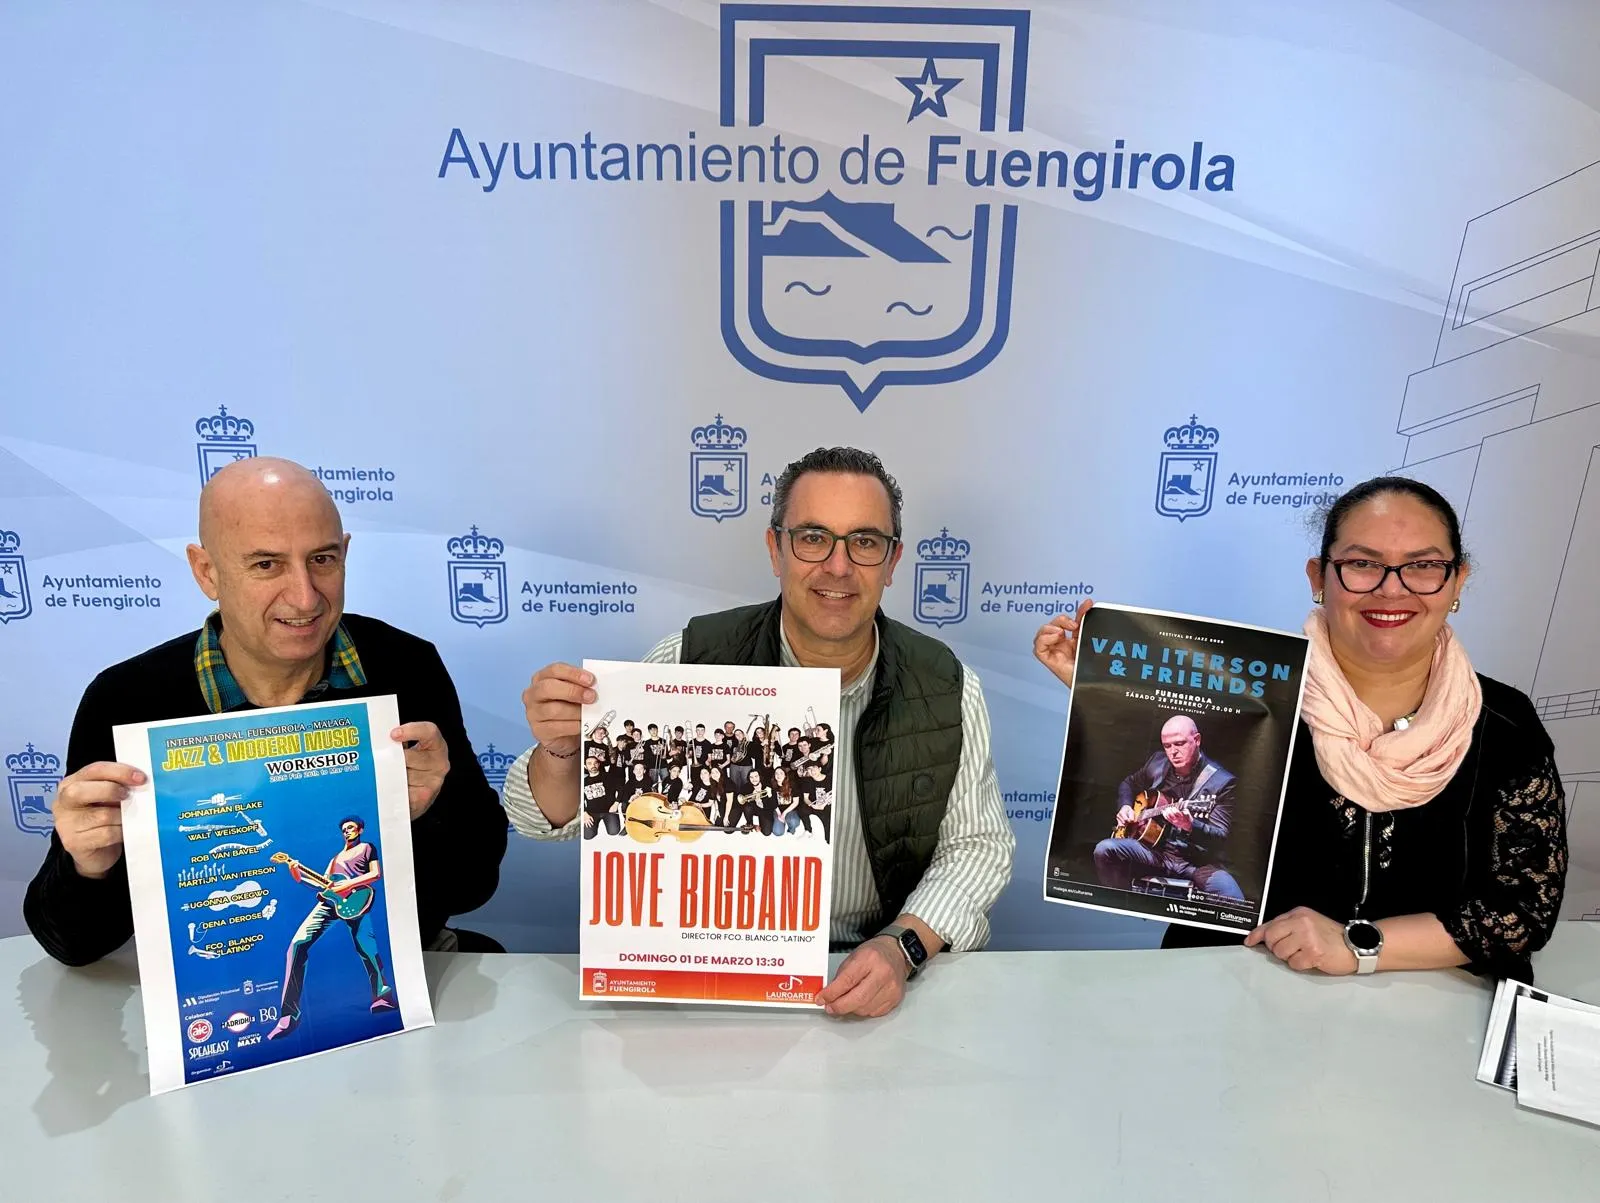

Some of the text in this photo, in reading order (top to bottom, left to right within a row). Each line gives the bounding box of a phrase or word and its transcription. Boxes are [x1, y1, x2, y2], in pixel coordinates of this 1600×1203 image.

[437, 127, 1236, 202] Ayuntamiento de Fuengirola
[312, 466, 395, 481] tamiento
[1228, 472, 1344, 489] Ayuntamiento
[1226, 491, 1339, 508] de Fuengirola
[42, 574, 161, 591] Ayuntamiento
[521, 581, 638, 597] Ayuntamiento
[981, 581, 1094, 597] Ayuntamiento
[45, 594, 161, 610] de Fuengirola
[522, 600, 635, 616] de Fuengirola
[980, 600, 1079, 616] de Fuengirol
[1091, 637, 1290, 681] VAN ITERSON
[1109, 659, 1266, 698] & FRIENDS
[645, 683, 777, 697] PLAZA REYES CATÓLICOS
[1155, 689, 1213, 704] FUENGIROLA
[1125, 690, 1156, 702] SÁBADO
[1169, 698, 1203, 709] FEBRERO
[166, 729, 244, 747] INTERNATIONAL
[246, 723, 306, 739] FUENGIROLA
[162, 727, 359, 771] JAZZ & MODERN MUSIC
[265, 751, 359, 775] WORKSHOP
[178, 801, 263, 820] JOHNATHAN BLAKE
[187, 831, 212, 841] WALT
[191, 846, 260, 863] ROB VAN BAVEL
[220, 873, 239, 881] VAN
[240, 866, 276, 878] ITERSON
[190, 889, 270, 909] UGONNA OKEGWO
[589, 851, 822, 931] JOVE BIGBAND
[202, 912, 263, 930] DENA DEROSE
[1220, 911, 1252, 923] Culturama
[205, 934, 264, 951] FCO. BLANCO
[681, 932, 816, 943] DIRECTOR FCO. BLANCO "LATINO"
[619, 952, 785, 967] DOMINGO 01 DE MARZO 13:30
[766, 991, 814, 1000] LAUROARTE
[259, 1006, 278, 1022] BQ
[237, 1036, 262, 1048] MAXY
